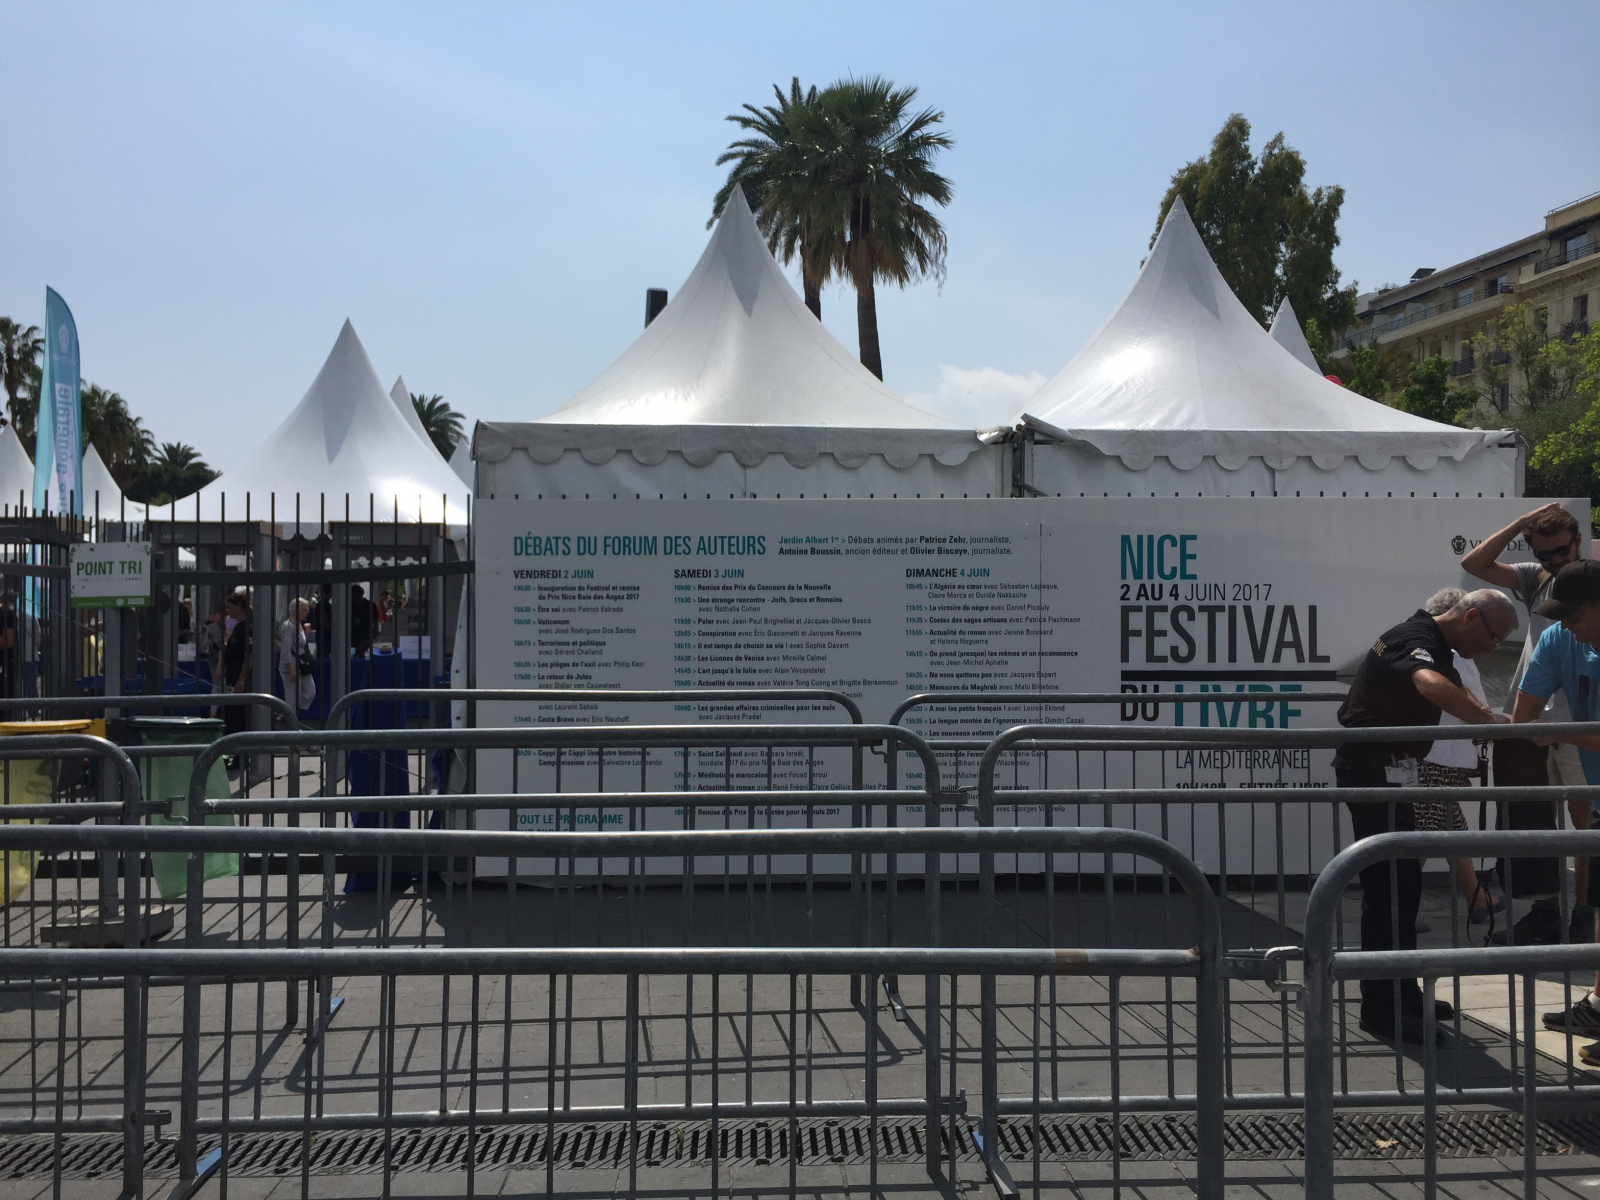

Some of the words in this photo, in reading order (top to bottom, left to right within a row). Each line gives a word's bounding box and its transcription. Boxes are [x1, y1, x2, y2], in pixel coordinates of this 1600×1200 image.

[513, 532, 571, 555] DÉBATS
[577, 536, 598, 555] DU
[604, 536, 657, 555] FORUM
[663, 536, 692, 555] DES
[696, 536, 766, 555] AUTEURS
[779, 536, 803, 544] Jardin
[805, 536, 828, 544] Albert
[848, 536, 874, 544] Débats
[876, 536, 903, 544] animés
[905, 537, 917, 546] par
[920, 536, 947, 544] Patrice
[949, 536, 968, 545] Zehr,
[970, 536, 1012, 546] journaliste,
[779, 547, 809, 555] Antoine
[810, 547, 843, 556] Boussin,
[845, 547, 870, 555] ancien
[872, 547, 898, 555] éditeur
[910, 547, 935, 555] Olivier
[937, 547, 970, 557] Biscaye,
[971, 547, 1013, 557] journaliste.
[1121, 534, 1197, 580] NICE
[76, 562, 115, 575] POINT
[119, 560, 142, 575] TRI
[906, 568, 957, 577] DIMANCHE
[960, 568, 965, 577] 4
[967, 568, 990, 577] JUIN
[513, 570, 562, 579] VENDREDI
[563, 570, 569, 579] 2
[571, 570, 594, 579] JUIN
[674, 569, 712, 578] SAMEDI
[714, 569, 720, 578] 3
[721, 569, 744, 578] JUIN
[1120, 584, 1132, 601] 2
[1136, 584, 1164, 601] AU
[1168, 584, 1179, 601] 4
[1184, 584, 1227, 601] JUIN
[1232, 584, 1272, 601] 2017
[711, 597, 734, 605] étrange
[1121, 605, 1331, 663] FESTIVAL
[1121, 685, 1160, 722] DU
[558, 815, 624, 824] PRGRAMME
